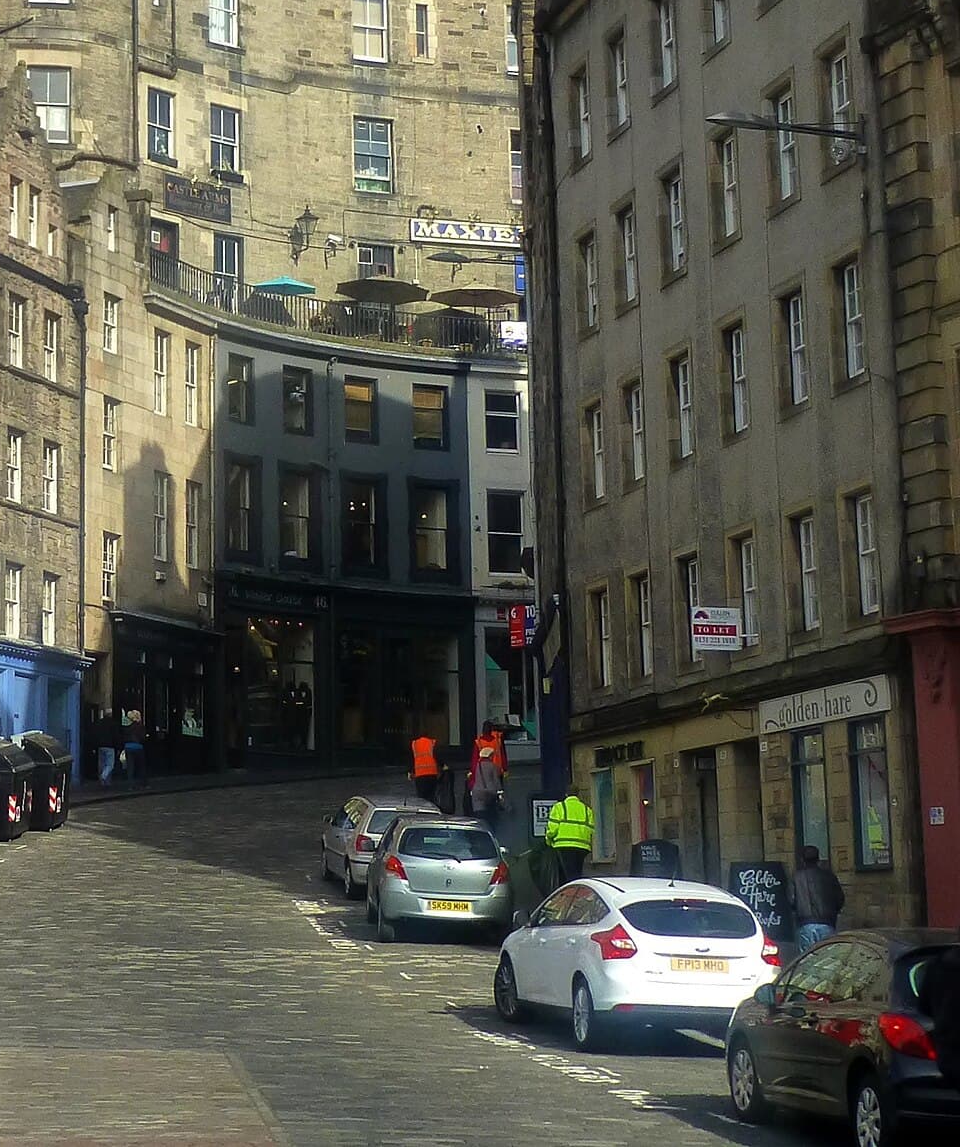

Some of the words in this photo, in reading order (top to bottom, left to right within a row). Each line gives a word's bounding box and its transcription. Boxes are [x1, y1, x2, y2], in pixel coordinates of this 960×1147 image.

[697, 626, 710, 634] TO
[713, 626, 730, 634] LET
[431, 901, 452, 910] SK59
[677, 960, 701, 970] FP13
